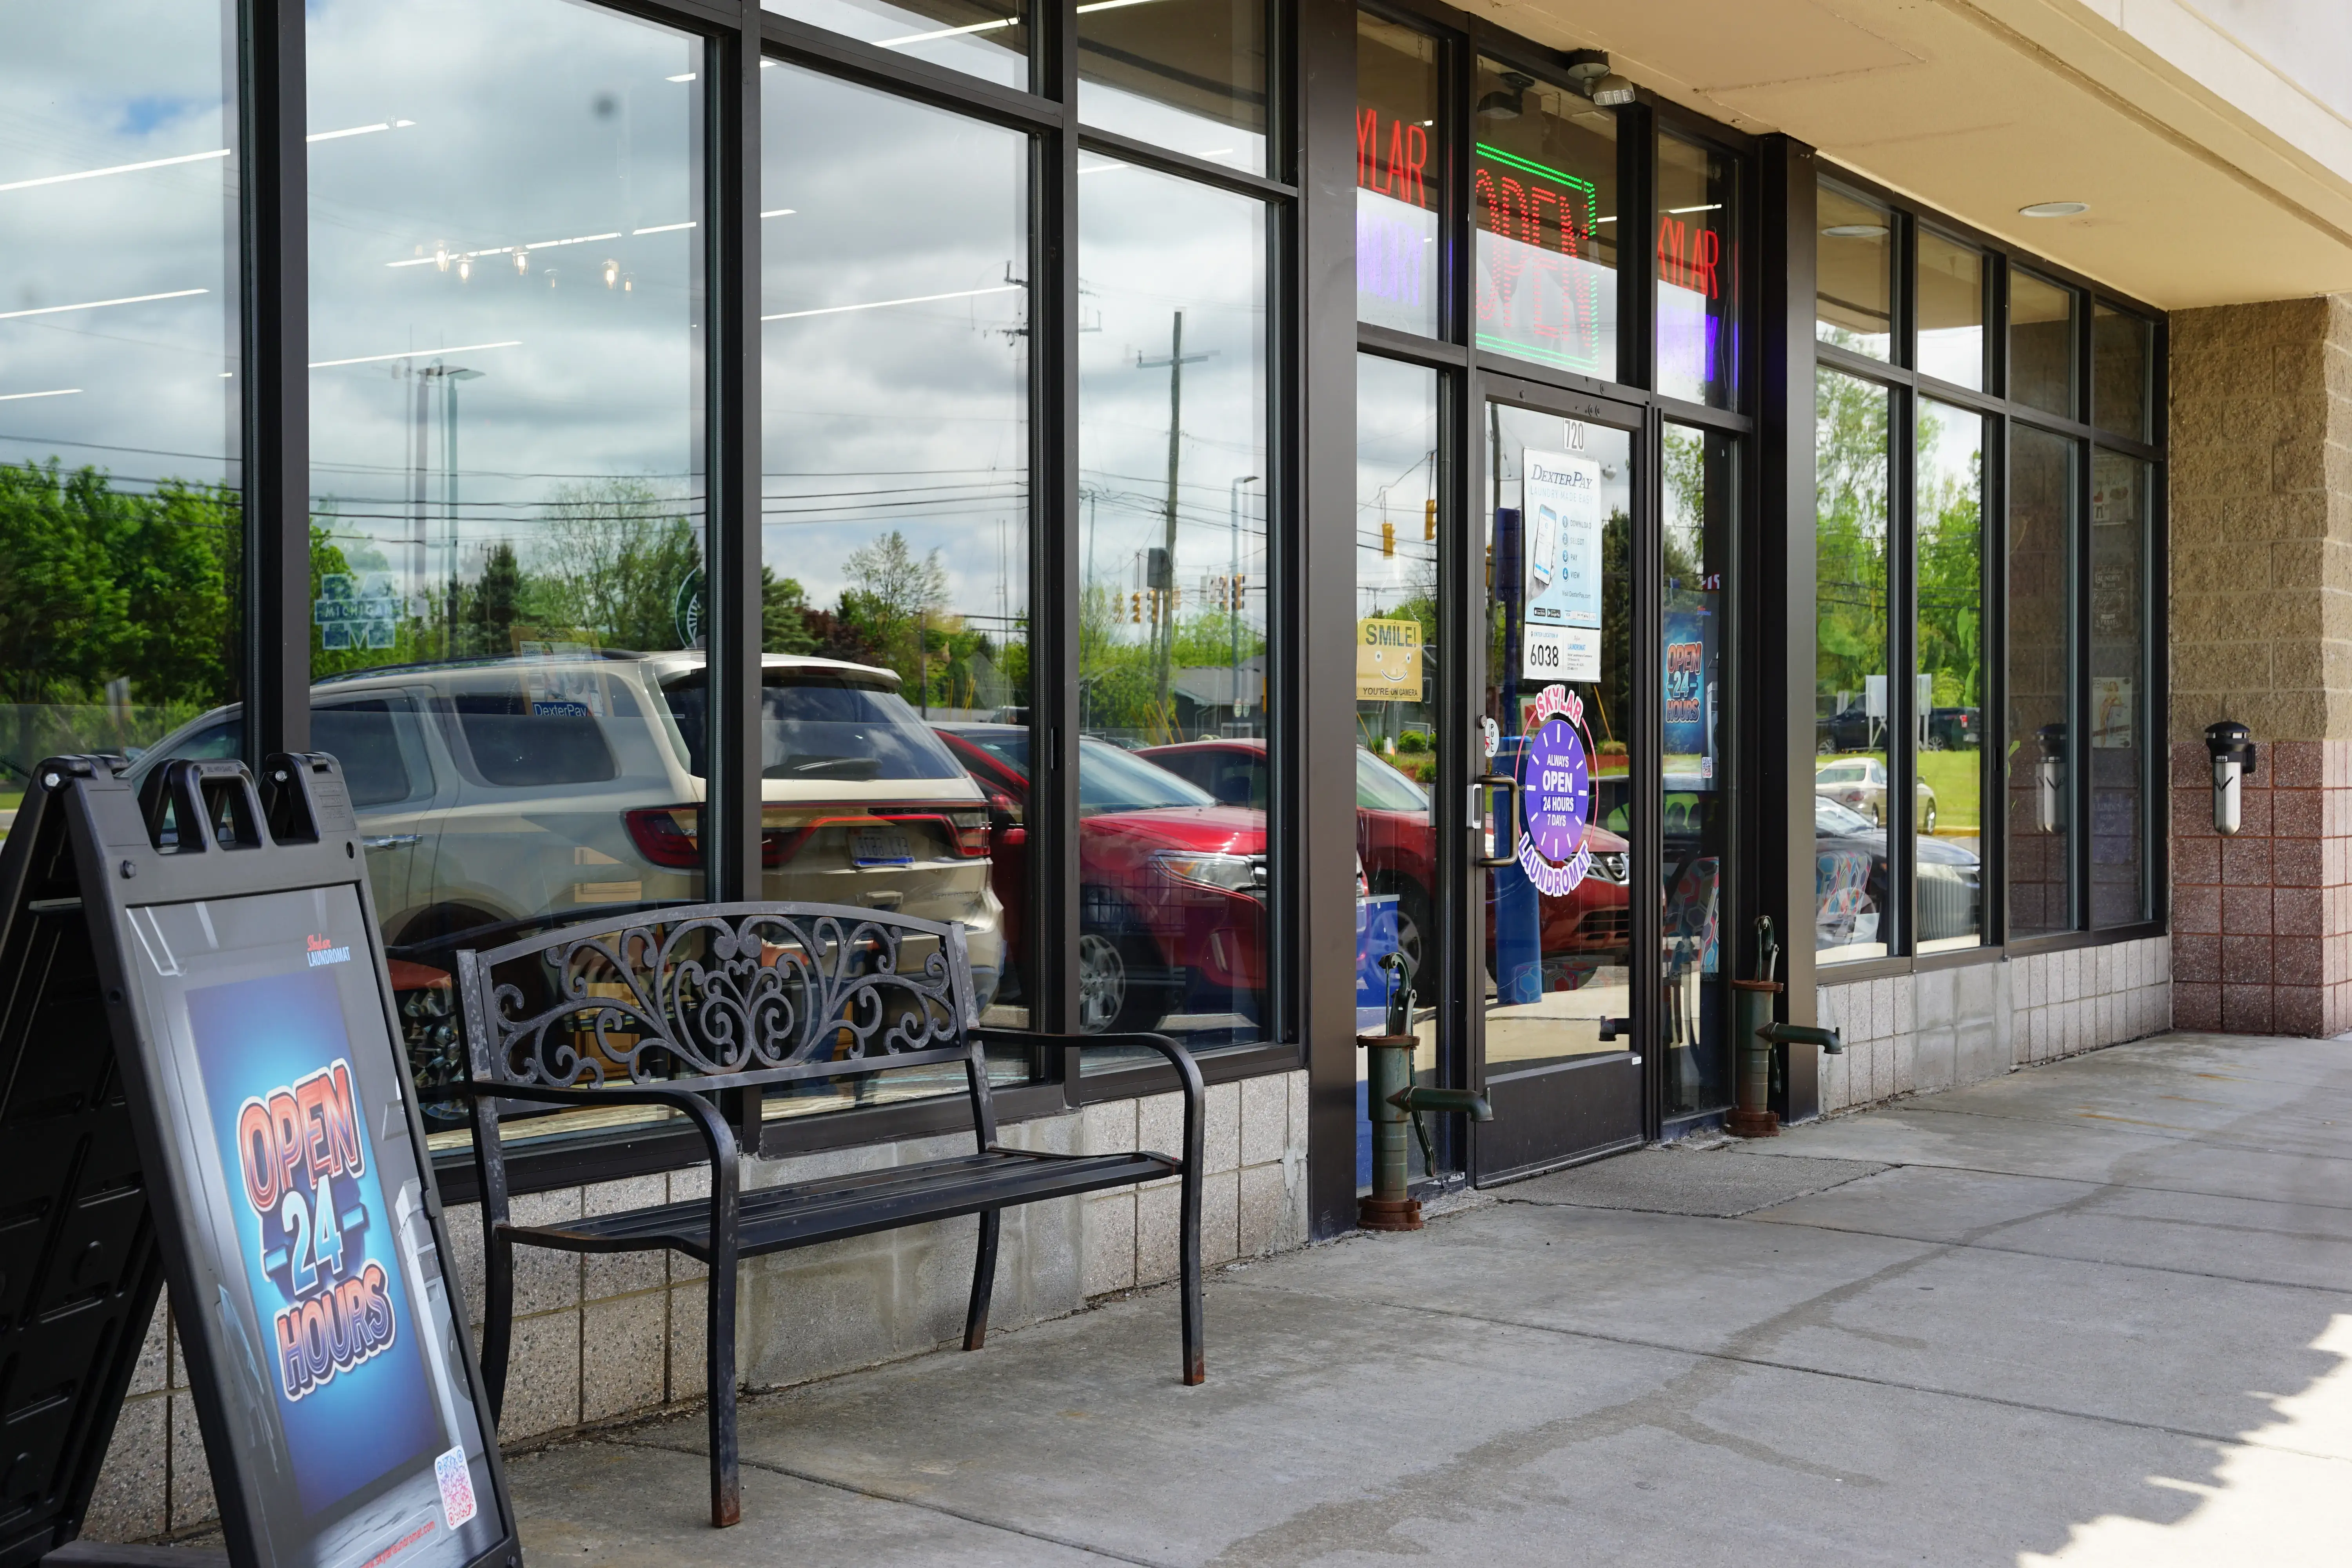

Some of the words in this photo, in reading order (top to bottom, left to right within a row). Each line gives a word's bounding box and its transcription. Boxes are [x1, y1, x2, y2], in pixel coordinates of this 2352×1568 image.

[1564, 419, 1584, 450] 720
[1530, 485, 1558, 499] LAUNDRY
[1561, 491, 1577, 502] MADE
[1579, 494, 1593, 505] EASY
[1570, 519, 1592, 529] DOWNLOAD
[1570, 537, 1584, 546] SELECT
[325, 604, 392, 618] MICHIGAN
[1365, 624, 1416, 648] SMILE!
[1530, 644, 1559, 667] 6038
[1667, 642, 1702, 675] OPEN
[1363, 687, 1389, 695] YOU'RE
[1536, 685, 1583, 727] SKYLAR
[1666, 698, 1700, 722] HOURS
[1547, 754, 1569, 768] ALWAYS
[1542, 769, 1573, 793] OPEN
[1543, 796, 1551, 811] 24
[1552, 797, 1574, 812] HOURS
[1547, 814, 1551, 826] 7
[1552, 814, 1566, 827] DAYS
[1518, 832, 1591, 897] LAUNDROMAT
[307, 946, 350, 967] LAUNDROMAT
[239, 1060, 363, 1214] OPEN
[276, 1261, 394, 1397] HOURS
